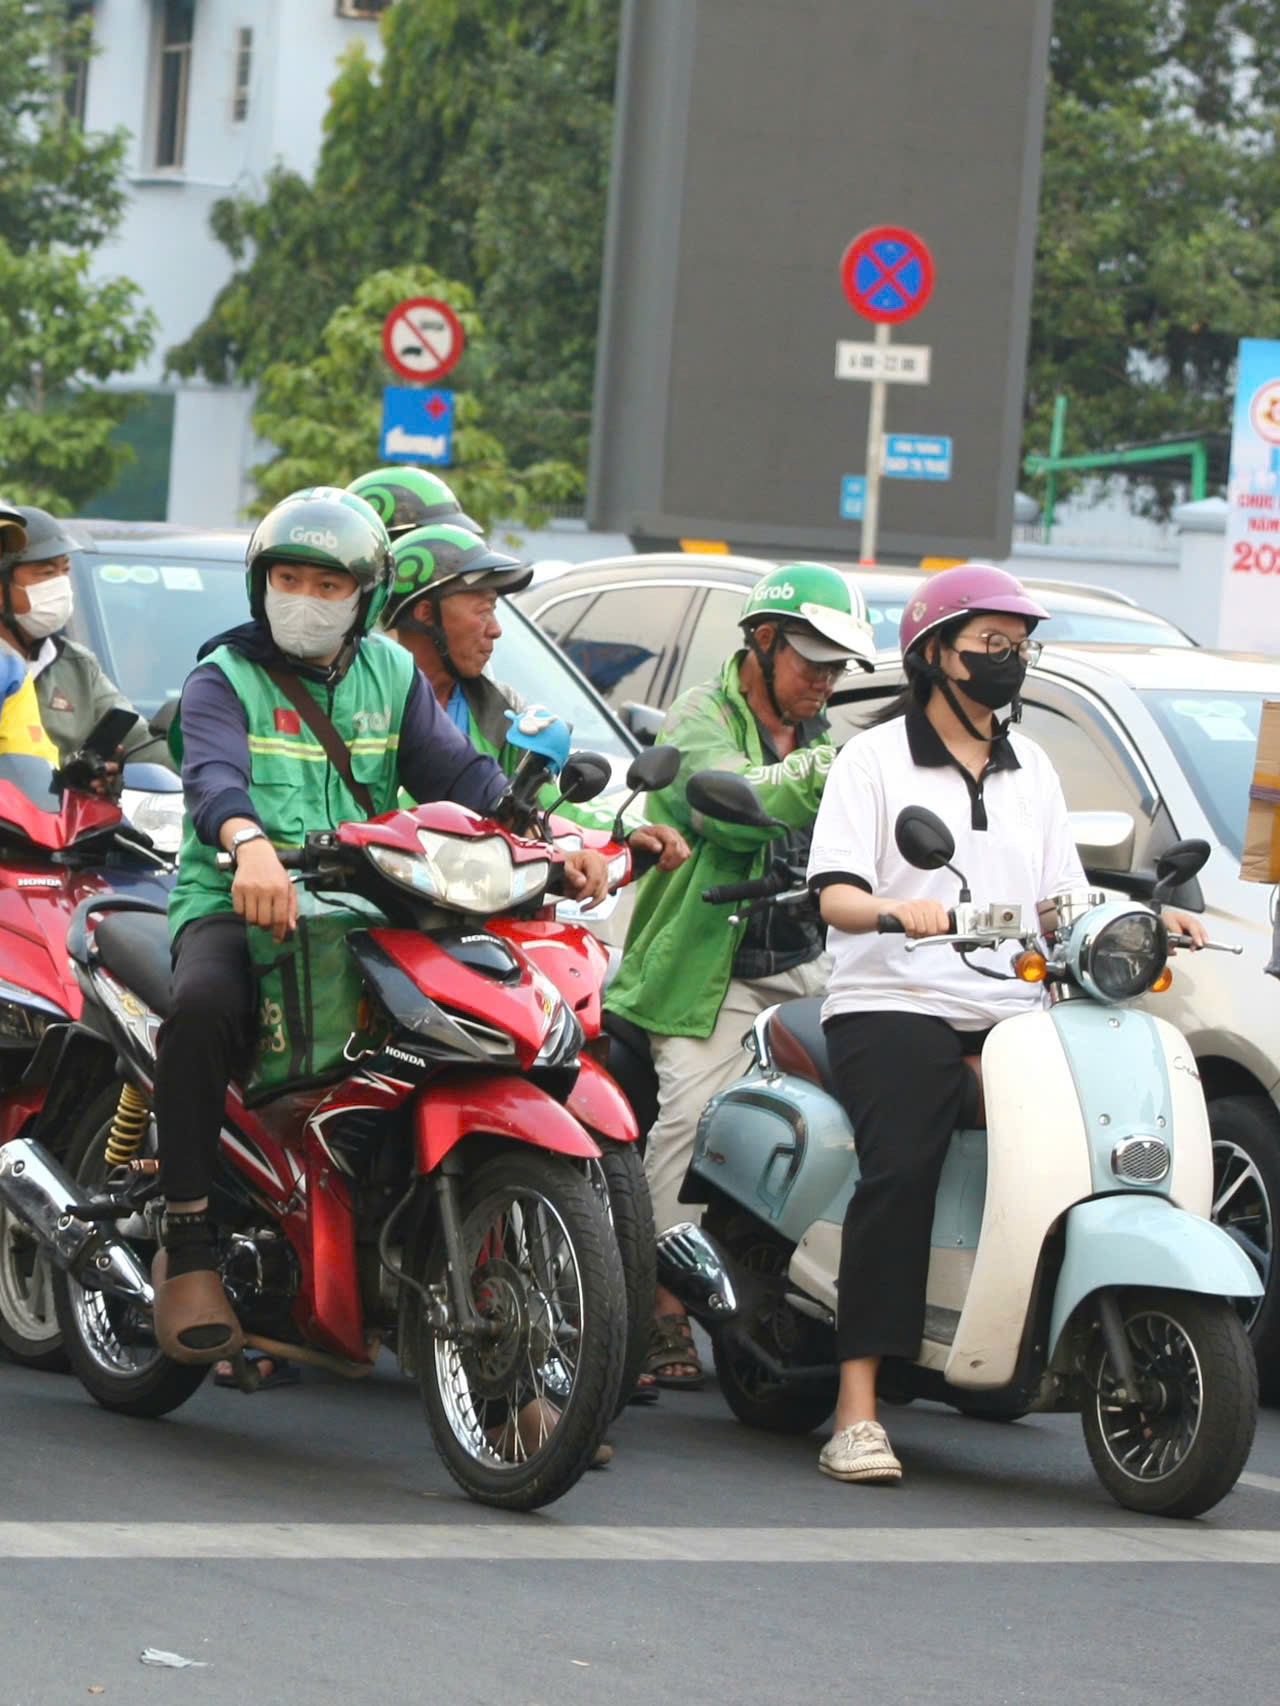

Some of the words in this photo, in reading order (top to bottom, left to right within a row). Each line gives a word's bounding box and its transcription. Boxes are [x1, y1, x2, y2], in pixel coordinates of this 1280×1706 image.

[289, 526, 338, 549] Grab
[754, 582, 795, 601] Grab
[17, 878, 63, 888] HONDA
[385, 1046, 426, 1068] HONDA
